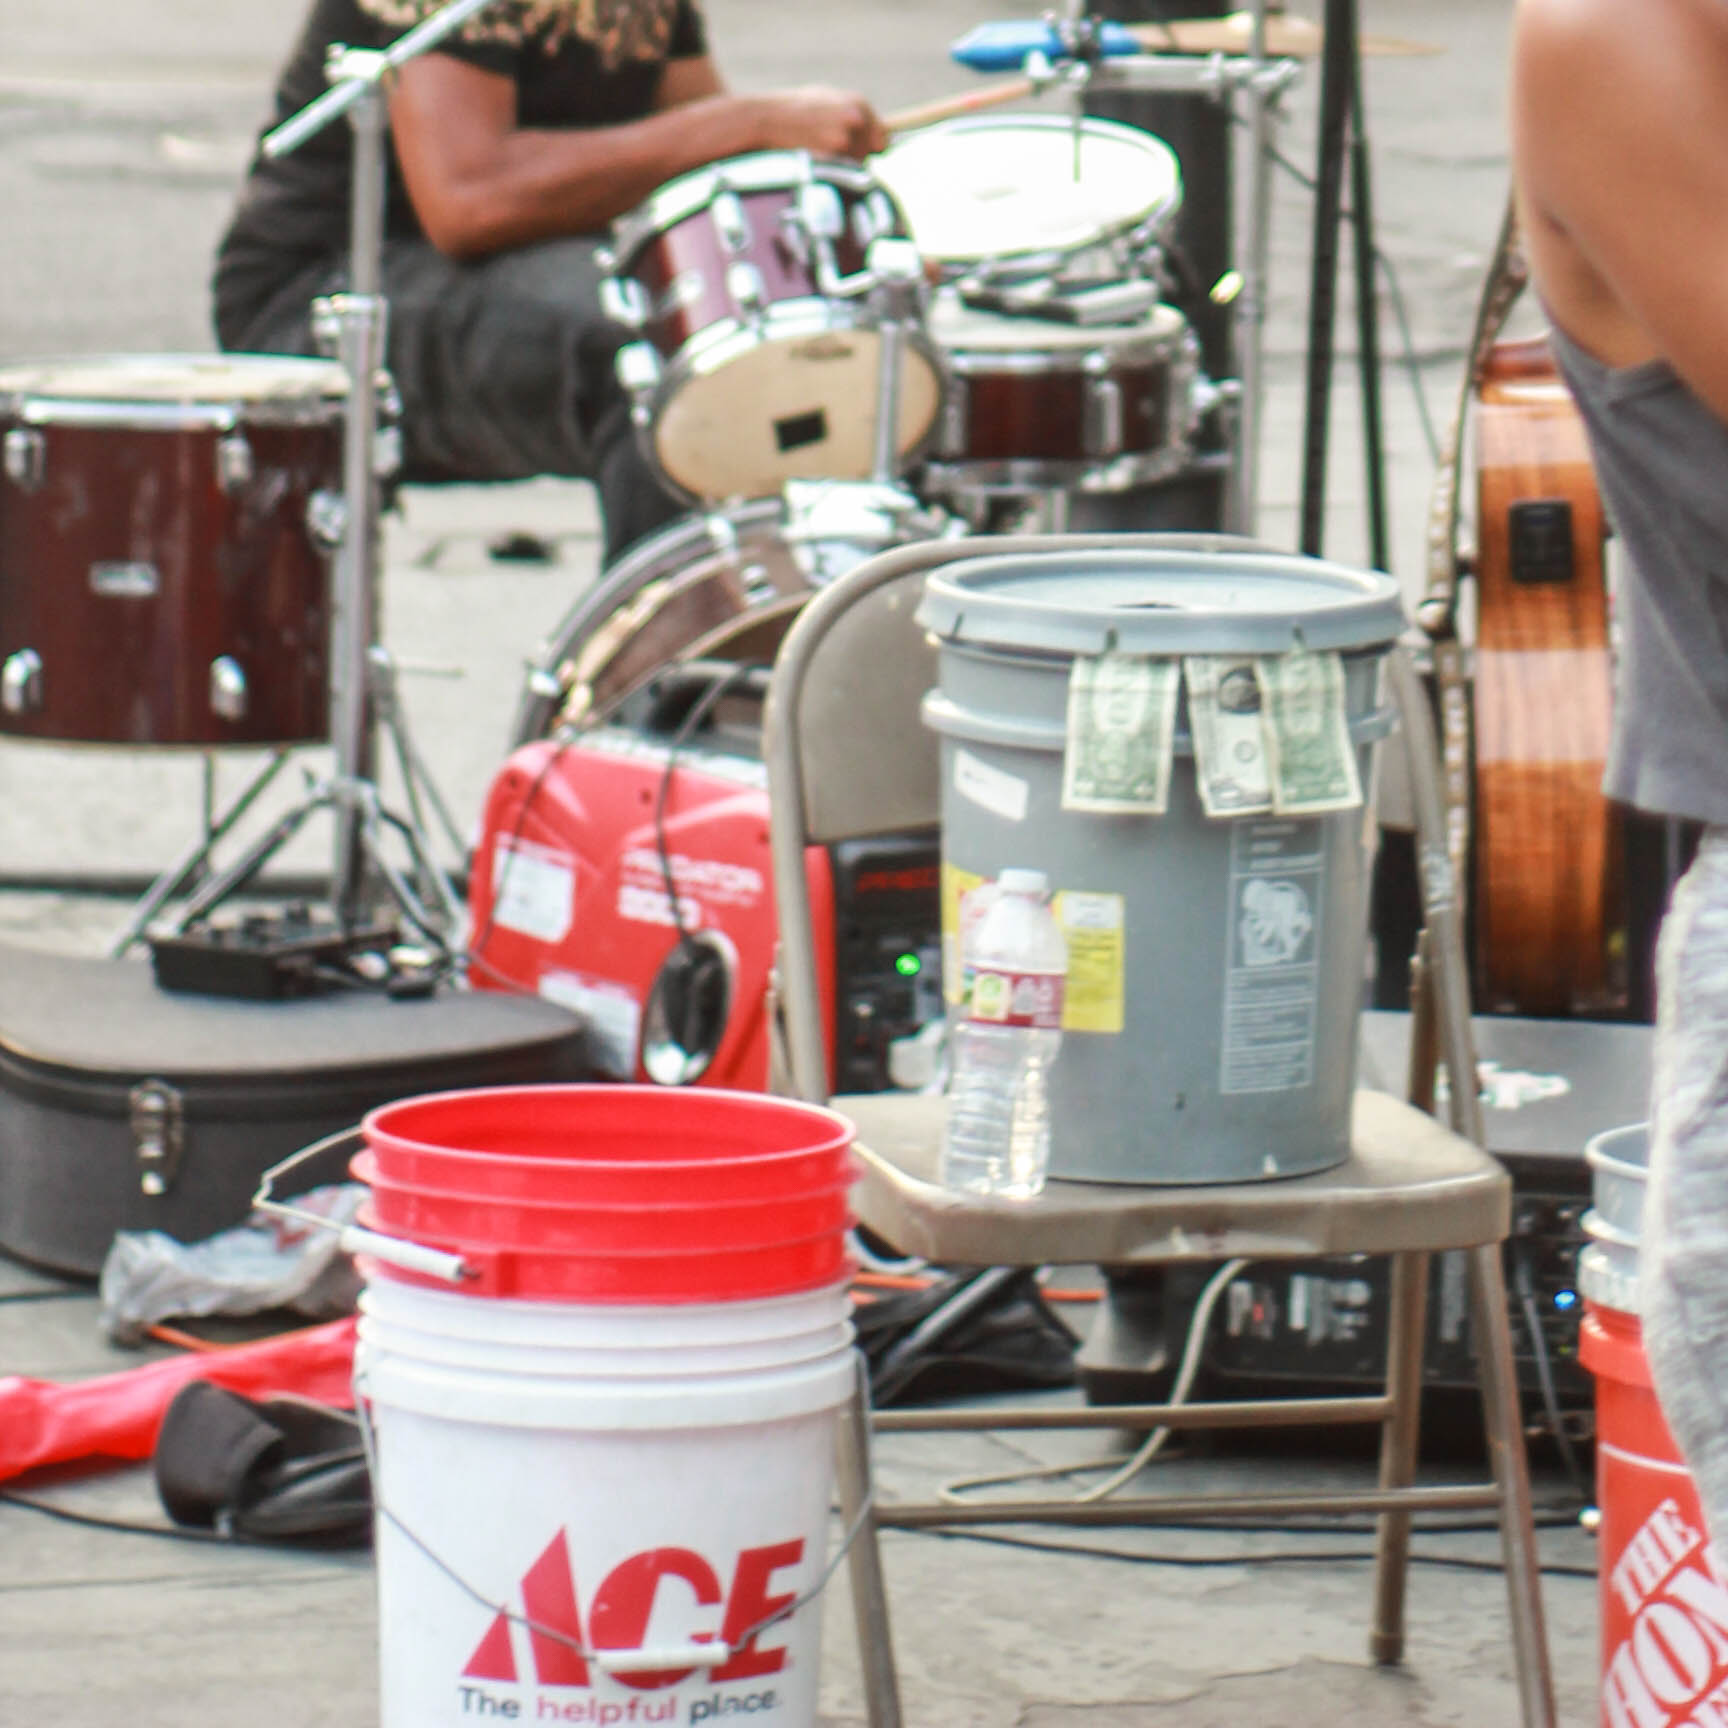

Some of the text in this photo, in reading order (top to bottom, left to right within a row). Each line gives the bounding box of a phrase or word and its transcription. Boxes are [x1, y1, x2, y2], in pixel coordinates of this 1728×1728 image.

[460, 1524, 806, 1691] ACE
[1611, 1497, 1702, 1616] THE
[458, 1686, 521, 1719] The
[536, 1695, 676, 1727] helpful
